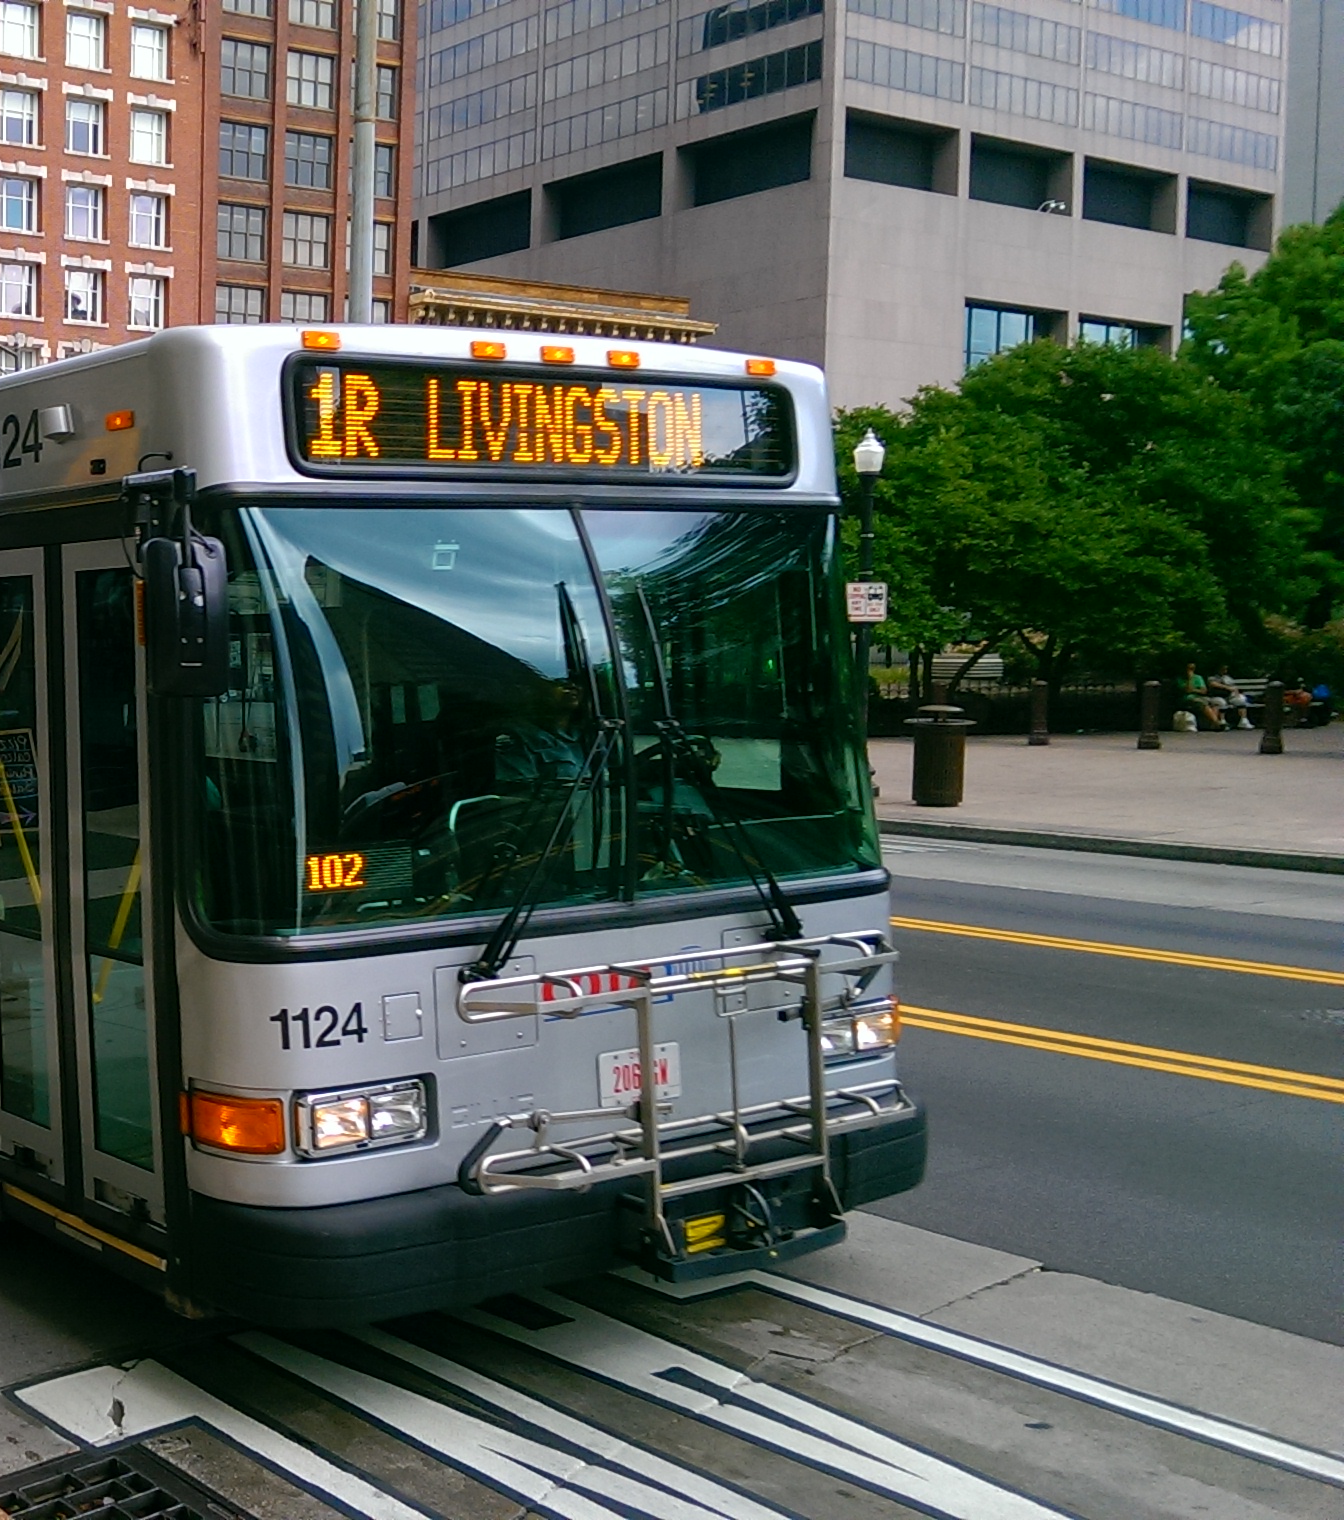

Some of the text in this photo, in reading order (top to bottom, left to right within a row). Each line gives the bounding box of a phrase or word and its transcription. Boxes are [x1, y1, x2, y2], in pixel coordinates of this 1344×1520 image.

[310, 372, 703, 468] 1R LIVINGSTON
[308, 853, 364, 890] 102
[269, 1001, 368, 1051] 1124
